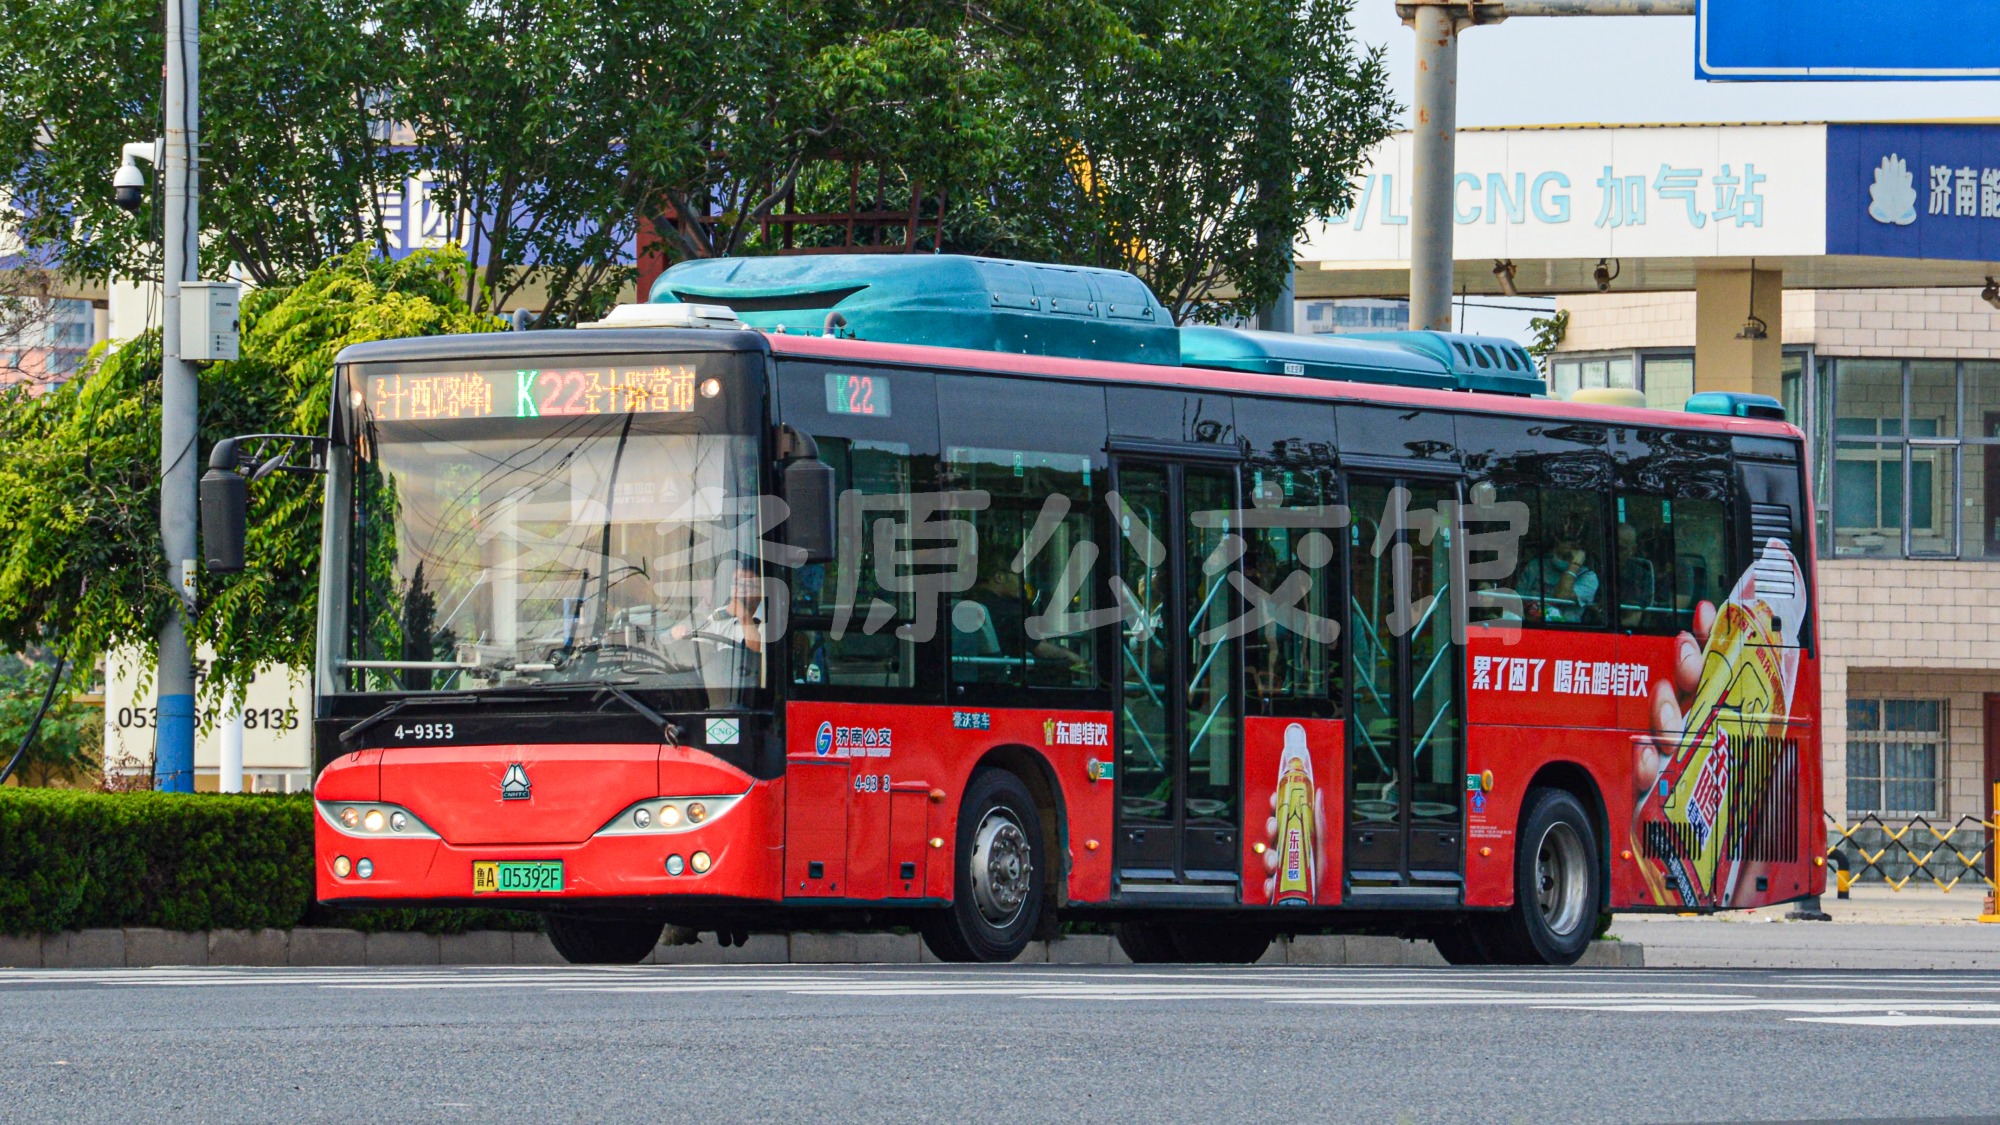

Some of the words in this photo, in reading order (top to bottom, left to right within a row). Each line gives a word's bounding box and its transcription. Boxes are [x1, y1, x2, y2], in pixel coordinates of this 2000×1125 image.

[1594, 162, 1767, 229] 加气站
[1928, 165, 2000, 218] 济南能
[517, 369, 586, 418] K22
[836, 375, 874, 414] K22
[1472, 655, 1546, 692] 累了困了
[1553, 659, 1649, 697] 喝东鹏特饮
[394, 723, 454, 740] 4-9353
[712, 727, 732, 735] CNG
[836, 726, 891, 747] 济南公交
[953, 711, 990, 730] 豪沃客车
[1056, 720, 1108, 746] 东鹏特饮
